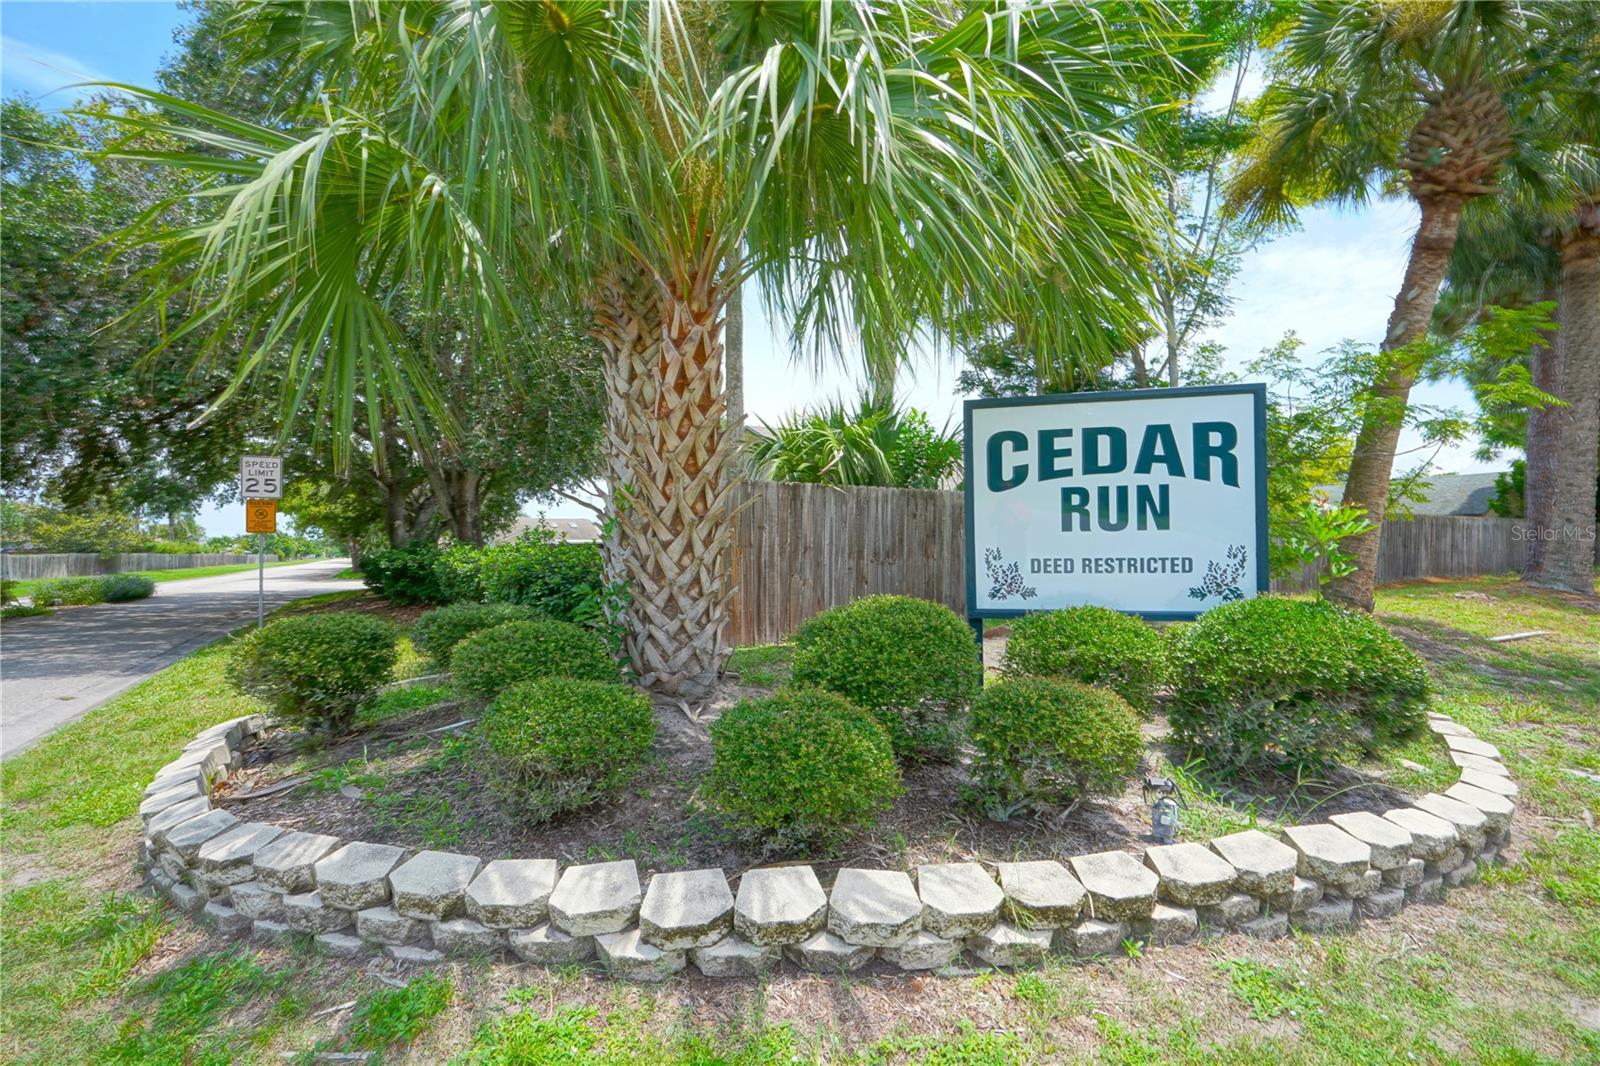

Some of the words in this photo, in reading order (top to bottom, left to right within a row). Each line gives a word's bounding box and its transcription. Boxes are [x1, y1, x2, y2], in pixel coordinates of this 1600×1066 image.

[986, 421, 1240, 493] CEDAR
[245, 478, 277, 493] 25
[1061, 484, 1170, 532] RUN
[1030, 558, 1075, 574] DEED
[1081, 557, 1193, 574] RESTRICTED
